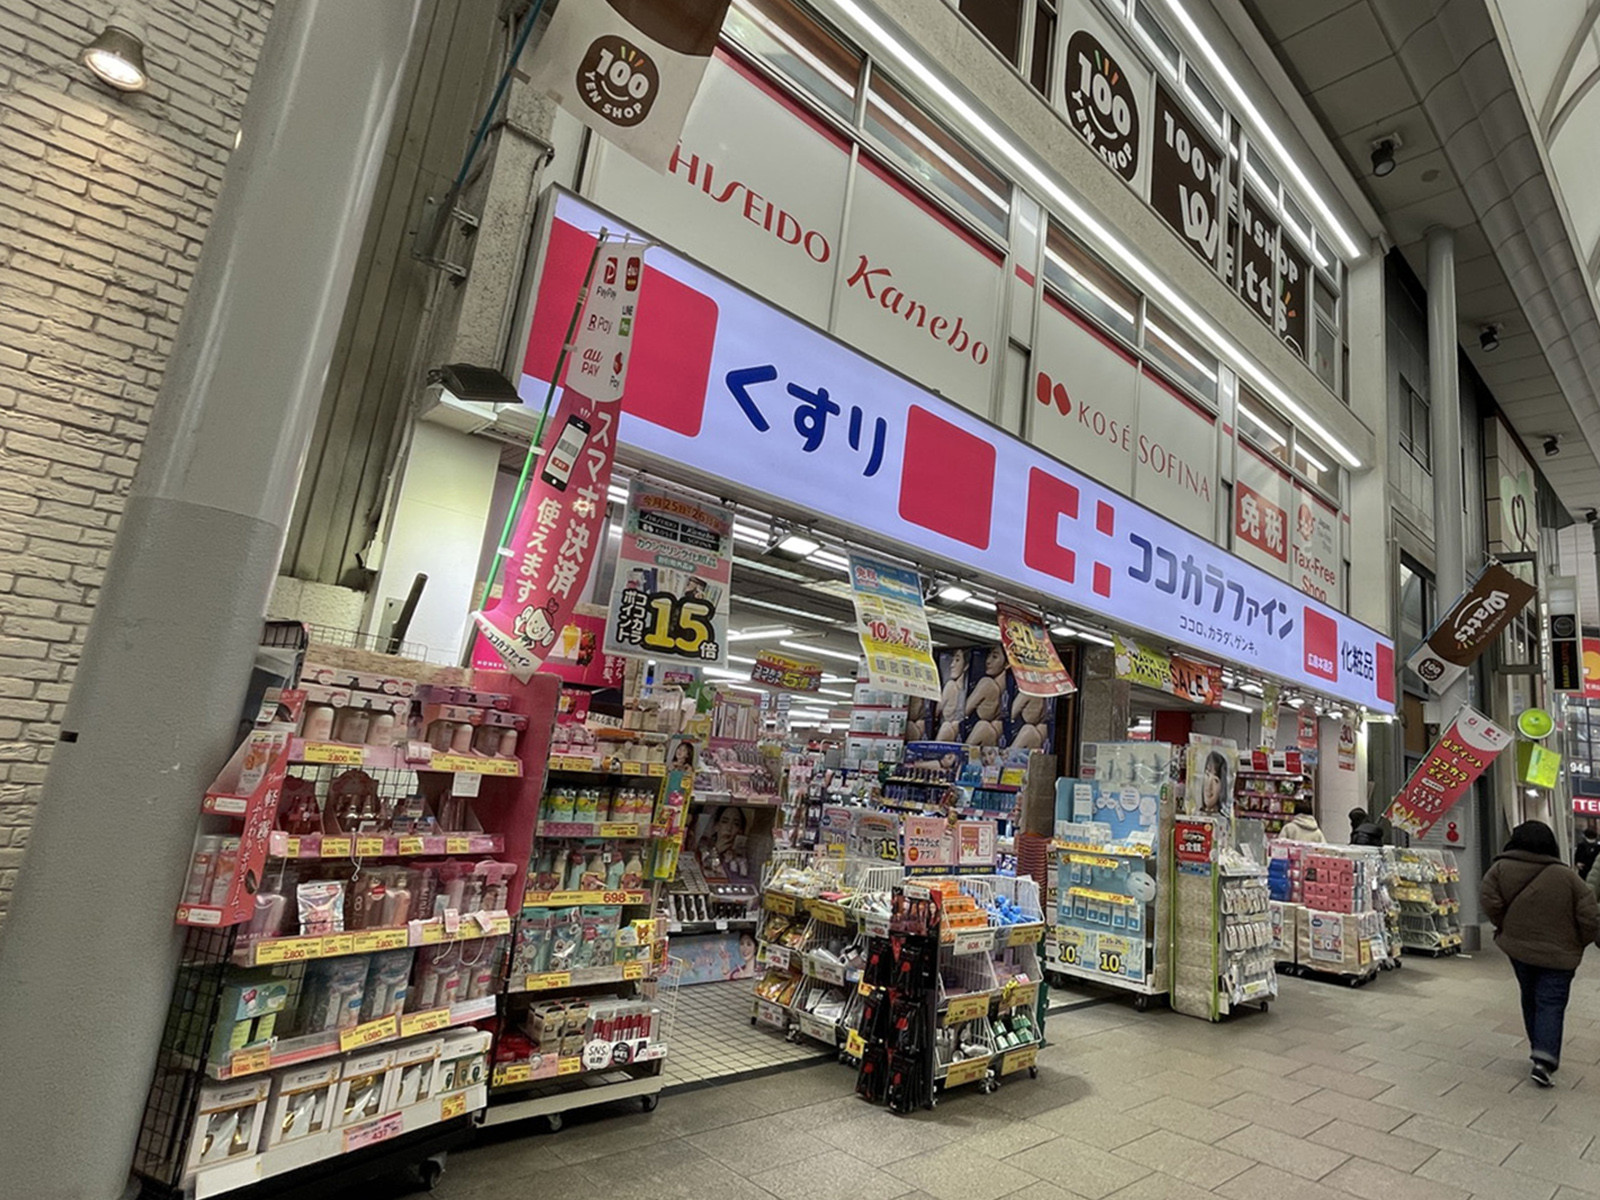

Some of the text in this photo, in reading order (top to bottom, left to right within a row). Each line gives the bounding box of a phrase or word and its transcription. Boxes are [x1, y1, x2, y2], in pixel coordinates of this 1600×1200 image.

[596, 48, 650, 99] 100
[1078, 52, 1132, 136] 100
[584, 71, 643, 119] YEN SHOP
[1071, 89, 1133, 170] YEN SHOP
[667, 141, 831, 264] HISEIDO
[596, 286, 617, 301] PayPay
[846, 254, 989, 365] Kanebo
[581, 361, 601, 377] PAY
[582, 348, 604, 363] au
[725, 364, 888, 478] くすり
[1077, 400, 1212, 503] KOSÉ SOFINA
[1239, 491, 1284, 556] 免税
[516, 496, 563, 603] 使えます
[1291, 544, 1337, 586] Tax-Free
[1127, 532, 1295, 641] ココカラファイン
[617, 589, 638, 641] ポイント
[631, 593, 648, 643] ココカラ
[1454, 589, 1510, 643] Watts
[1169, 662, 1206, 698] SALE
[1341, 640, 1374, 682] 化粧品
[1432, 757, 1469, 782] ココカラ
[1441, 739, 1483, 769] dポイント
[1451, 757, 1460, 765] と
[1427, 767, 1459, 789] ポイント
[880, 838, 898, 860] 15
[603, 892, 626, 903] 698
[283, 950, 305, 960] 2,800
[375, 939, 394, 949] 2,800
[1060, 944, 1080, 964] 10
[1100, 953, 1125, 973] 10
[588, 1045, 606, 1056] SNS
